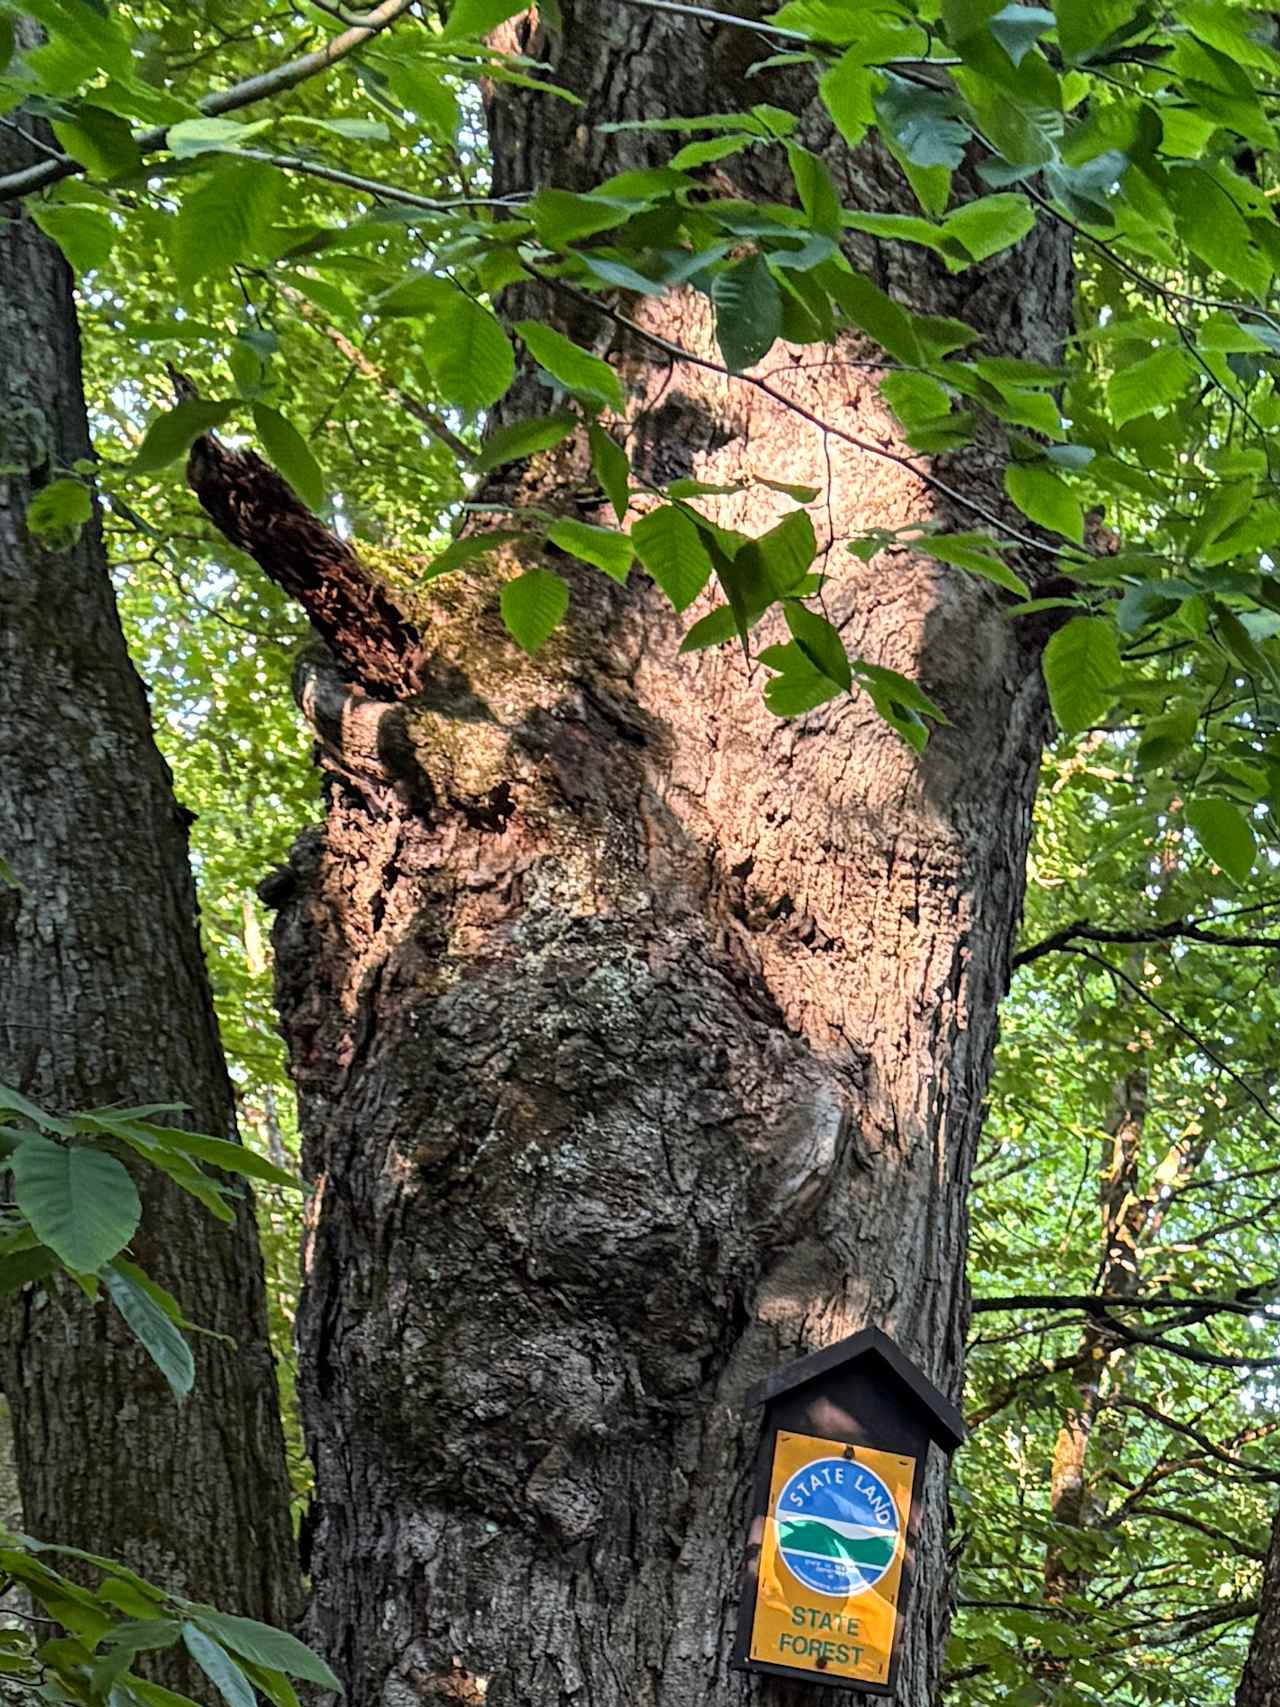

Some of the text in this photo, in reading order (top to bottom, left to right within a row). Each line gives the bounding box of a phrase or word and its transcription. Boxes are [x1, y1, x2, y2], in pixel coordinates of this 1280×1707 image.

[789, 1467, 891, 1525] STATE LAND
[791, 1605, 861, 1637] STATE
[779, 1632, 865, 1666] FOREST
